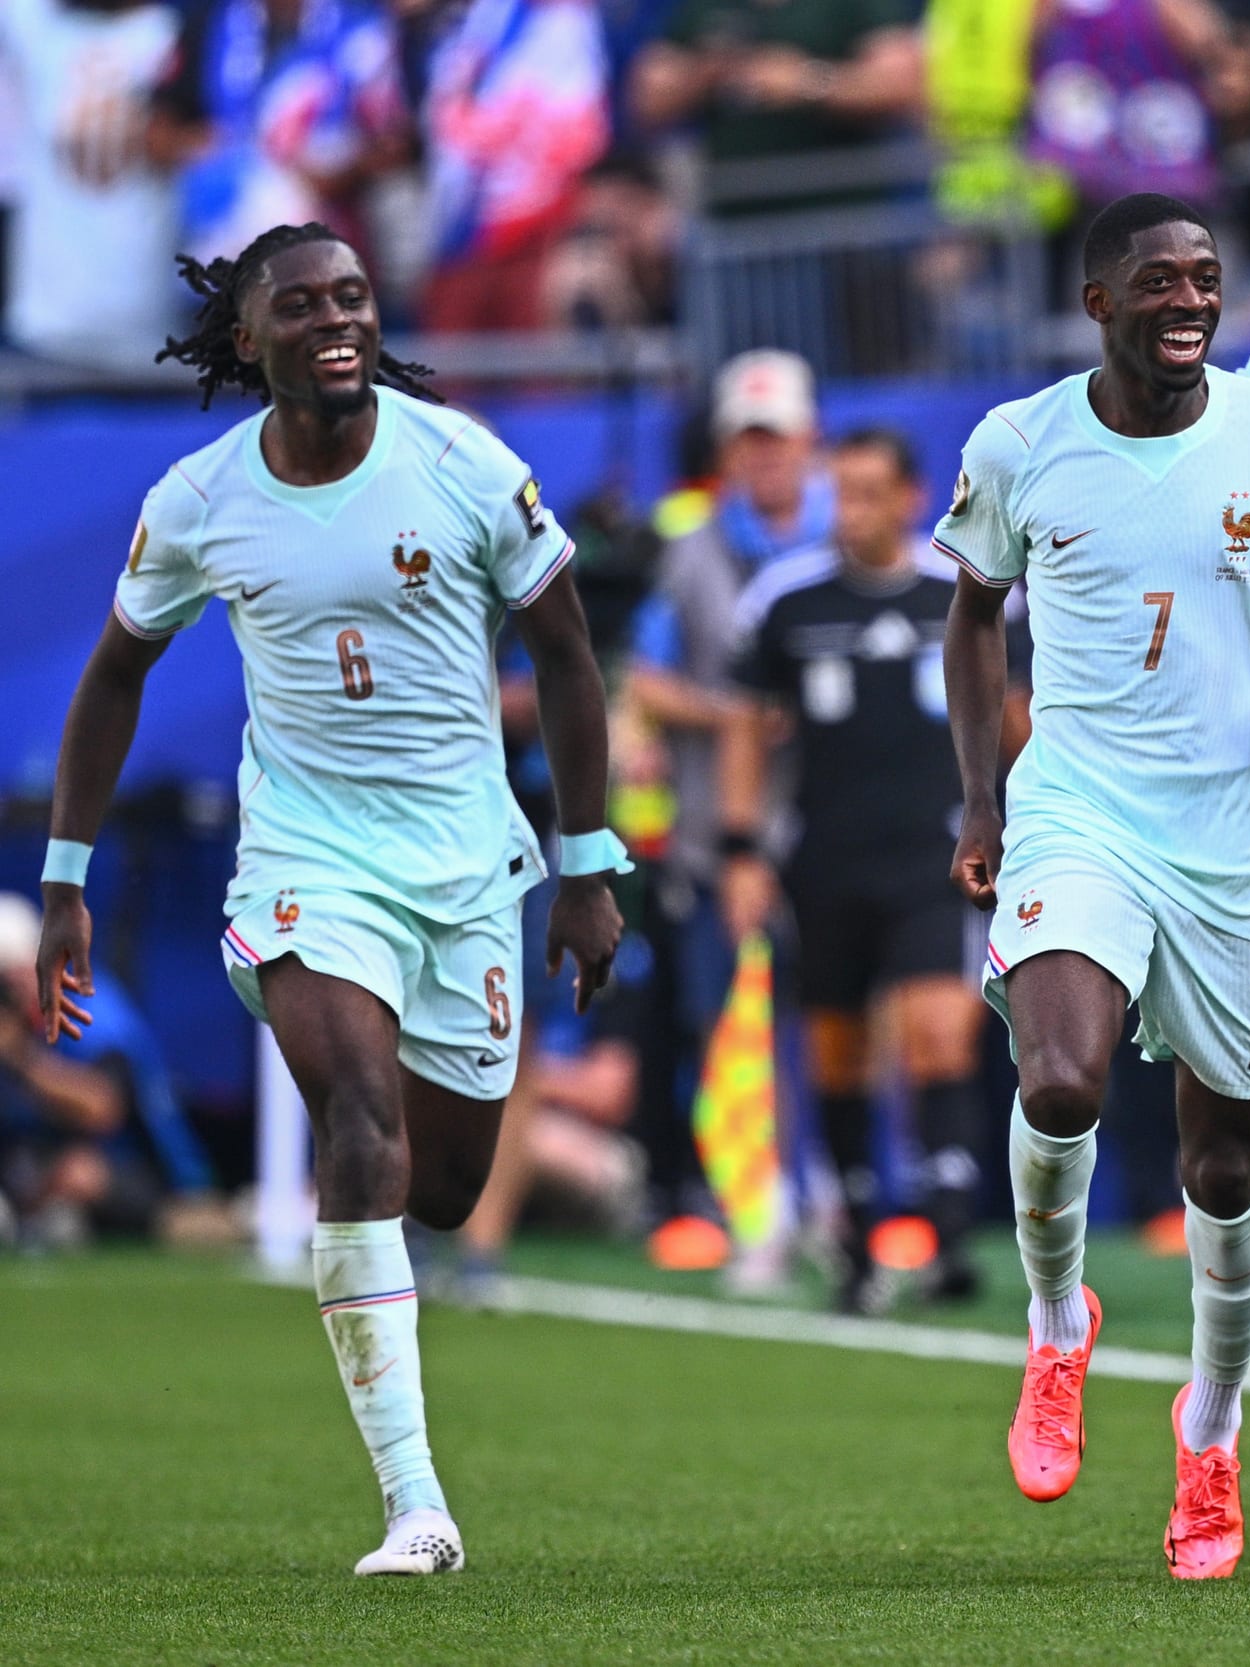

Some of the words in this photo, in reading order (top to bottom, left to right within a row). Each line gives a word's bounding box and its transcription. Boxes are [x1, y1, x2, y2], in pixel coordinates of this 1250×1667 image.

[337, 629, 374, 701] 6
[1143, 592, 1175, 671] 7
[483, 966, 511, 1041] 6
